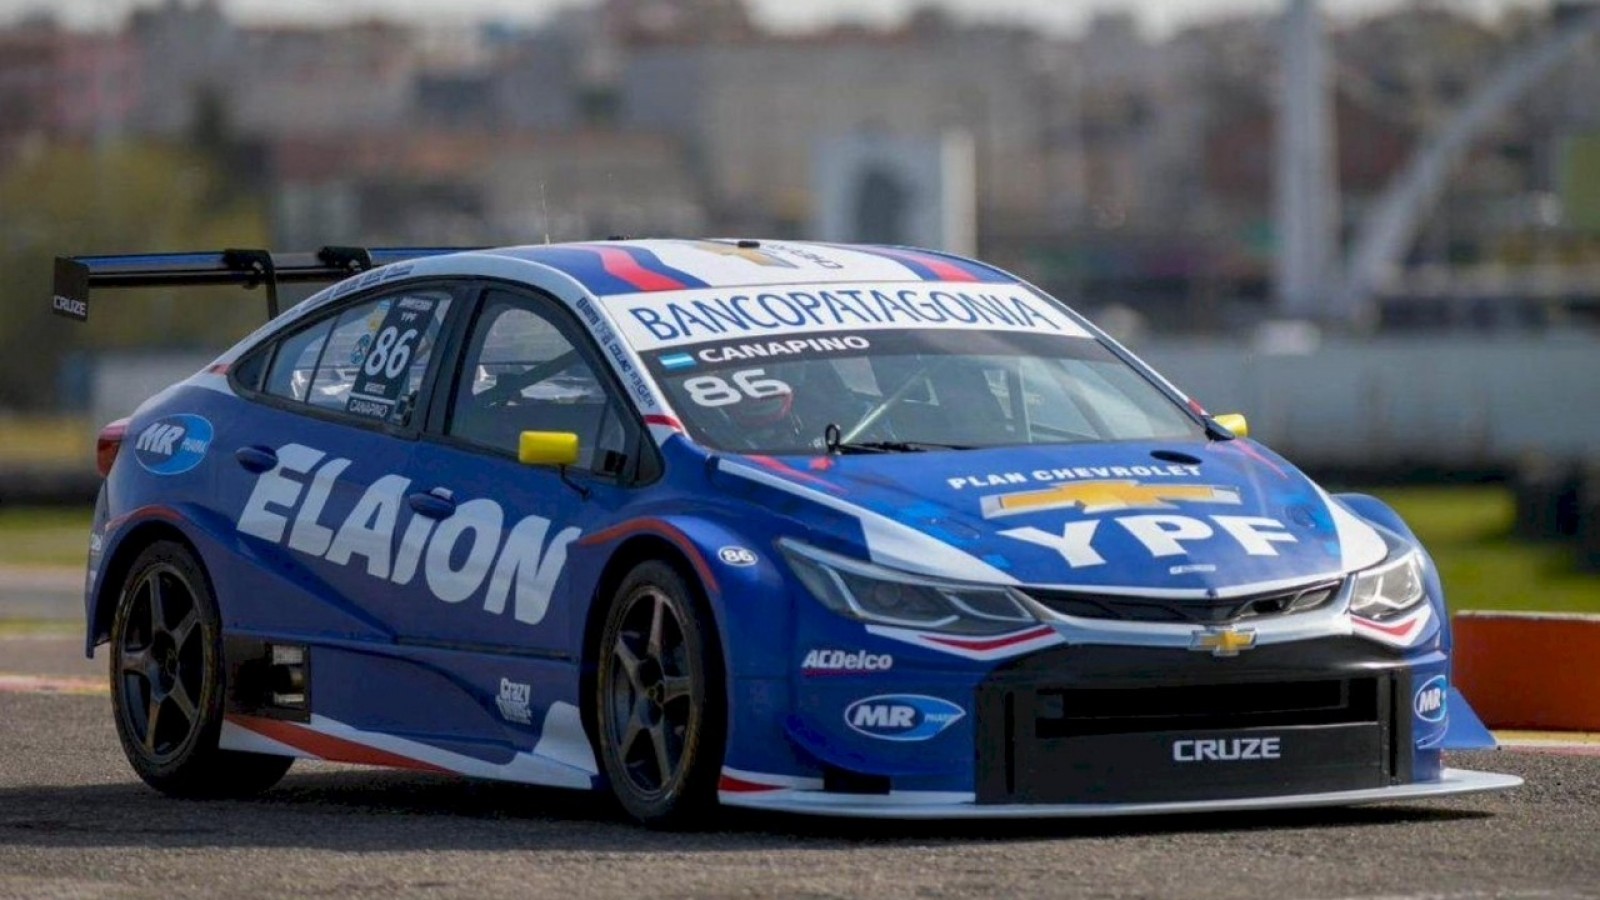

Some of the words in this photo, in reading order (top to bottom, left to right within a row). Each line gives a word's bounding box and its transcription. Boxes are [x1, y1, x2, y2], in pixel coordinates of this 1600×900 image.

[53, 295, 86, 316] CRUZE
[628, 290, 1061, 342] BANCOPATAGONIA
[365, 326, 418, 379] 86
[698, 335, 870, 363] CANAPINO
[683, 368, 792, 408] 86
[349, 399, 389, 417] CANAPINO
[135, 423, 186, 456] MR
[947, 471, 1027, 490] PLAN
[1031, 464, 1203, 482] CHEVROLET
[995, 514, 1298, 568] YPF
[724, 549, 754, 562] 86
[802, 650, 893, 671] ACDelco
[1419, 688, 1441, 713] MR
[854, 705, 916, 727] MR
[1173, 737, 1281, 762] CRUZE
